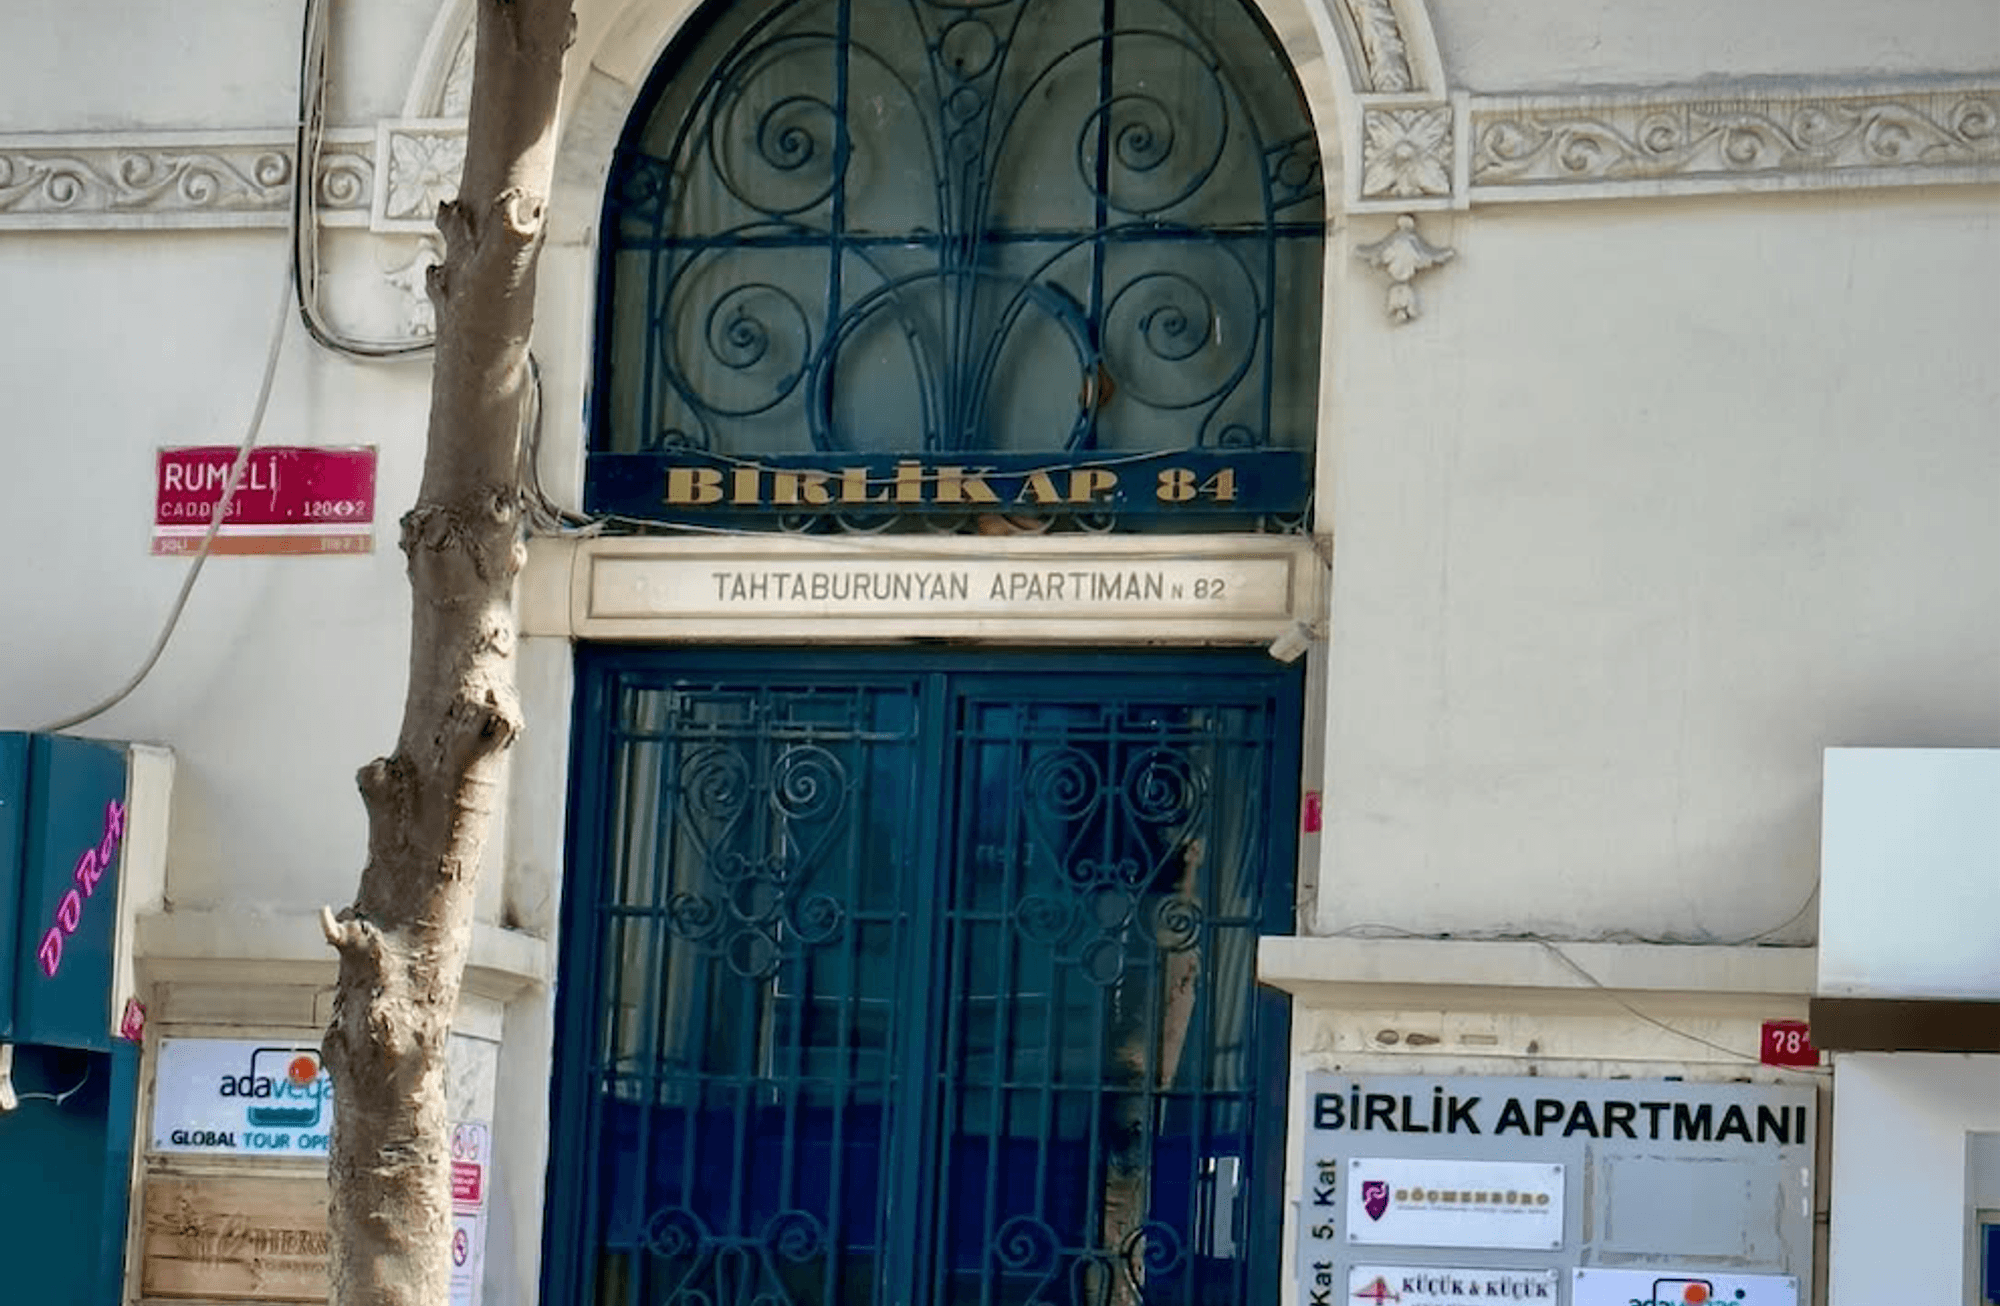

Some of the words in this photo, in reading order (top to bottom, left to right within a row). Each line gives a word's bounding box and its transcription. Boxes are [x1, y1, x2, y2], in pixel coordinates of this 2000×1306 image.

[1156, 467, 1238, 502] 84
[712, 573, 969, 601] TAHTABURUNYAN
[989, 572, 1164, 601] APARTIMAN
[1194, 577, 1226, 600] 82
[1313, 1084, 1482, 1135] BİRLİK
[1493, 1096, 1808, 1145] APARTMANI
[171, 1129, 237, 1147] GLOBAL
[242, 1131, 290, 1149] TOUR
[1312, 1158, 1337, 1207] Kat
[1311, 1217, 1335, 1241] 5.
[1309, 1260, 1333, 1306] Kat
